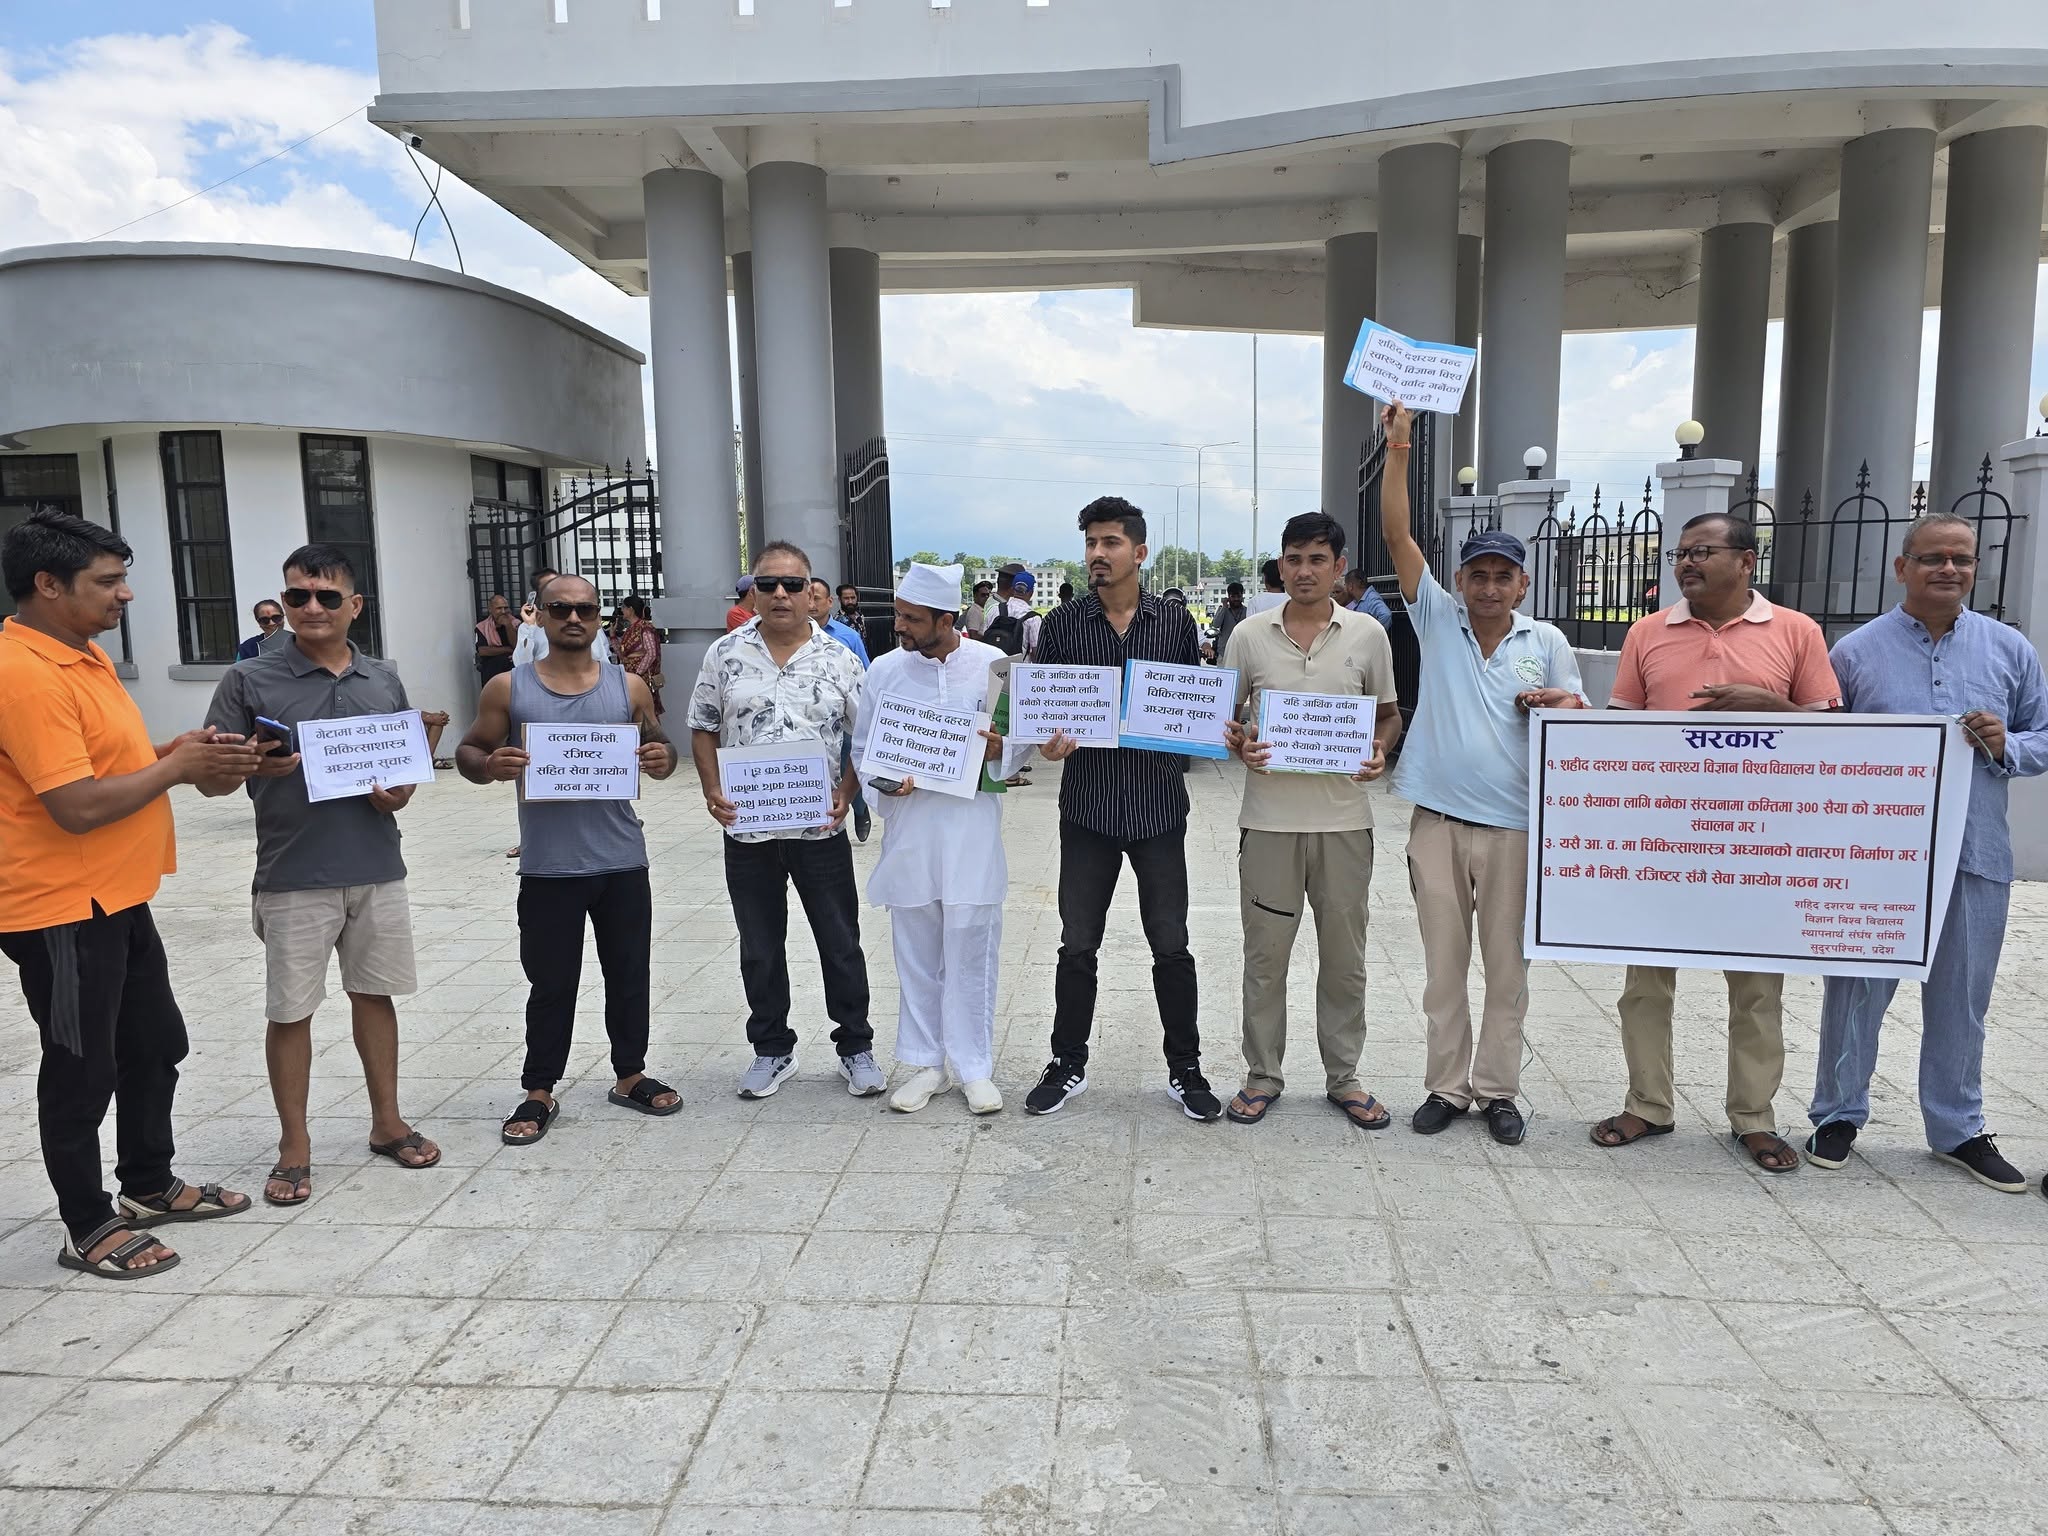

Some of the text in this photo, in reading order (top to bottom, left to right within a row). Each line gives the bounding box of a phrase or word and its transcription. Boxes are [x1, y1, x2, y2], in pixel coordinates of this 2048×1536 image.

[1440, 357, 1463, 367] चन्द
[1404, 364, 1437, 376] विज्ञान
[1144, 669, 1175, 682] गेटामा
[1199, 677, 1223, 688] पाली
[882, 700, 917, 716] तत्काल
[919, 709, 942, 723] शहिद
[315, 727, 352, 739] गेटामा
[381, 720, 409, 732] पाली
[879, 716, 900, 729] चन्द
[939, 729, 967, 743] विज्ञान
[1074, 728, 1087, 736] गर
[548, 733, 587, 743] तत्काल
[905, 738, 941, 756] विद्यालय
[942, 746, 957, 758] ऐन
[1326, 759, 1340, 767] गर
[1547, 759, 1557, 771] १.
[1560, 757, 1589, 771] शहीद
[1593, 760, 1628, 772] दशरथ
[1632, 760, 1656, 773] चन्द
[1659, 761, 1700, 774] स्वास्थ्य
[1703, 758, 1739, 774] विज्ञान
[1819, 761, 1837, 776] ऐन
[1907, 765, 1927, 778] गर
[536, 764, 628, 776] सहित सेवा आयोग
[765, 766, 781, 775] एक
[554, 783, 581, 792] गठन
[584, 783, 602, 792] गर
[1546, 793, 1926, 817] २. ६०० सैयाका लागि बनेका संरचनामा कम्तिमा ३०० सैया को अस्पताल
[1690, 817, 1735, 832] संचालन
[1738, 821, 1757, 833] गर
[1544, 838, 1556, 849] ३.
[1559, 835, 1580, 849] यसै
[1584, 839, 1603, 850] आ.
[1606, 839, 1618, 850] व.
[1621, 840, 1636, 851] मा
[1640, 837, 1726, 856] चिकित्साशास्त्र
[1796, 846, 1845, 860] वातारण
[1849, 845, 1895, 861] निर्माण
[1898, 849, 1919, 862] गर
[1543, 866, 1555, 876] ४.
[1585, 864, 1596, 878] नै
[1635, 866, 1682, 882] रजिष्टर
[1711, 869, 1736, 884] सेवा
[1739, 871, 1782, 887] आयोग
[1786, 876, 1819, 888] गठन
[1794, 899, 1820, 911] शहिद
[1823, 901, 1855, 911] दशरथ
[1859, 902, 1879, 912] चन्द
[1804, 913, 1904, 927] विज्ञान विश्व विद्यालय
[1876, 930, 1906, 941] समिति
[1872, 944, 1895, 955] प्रदेश
